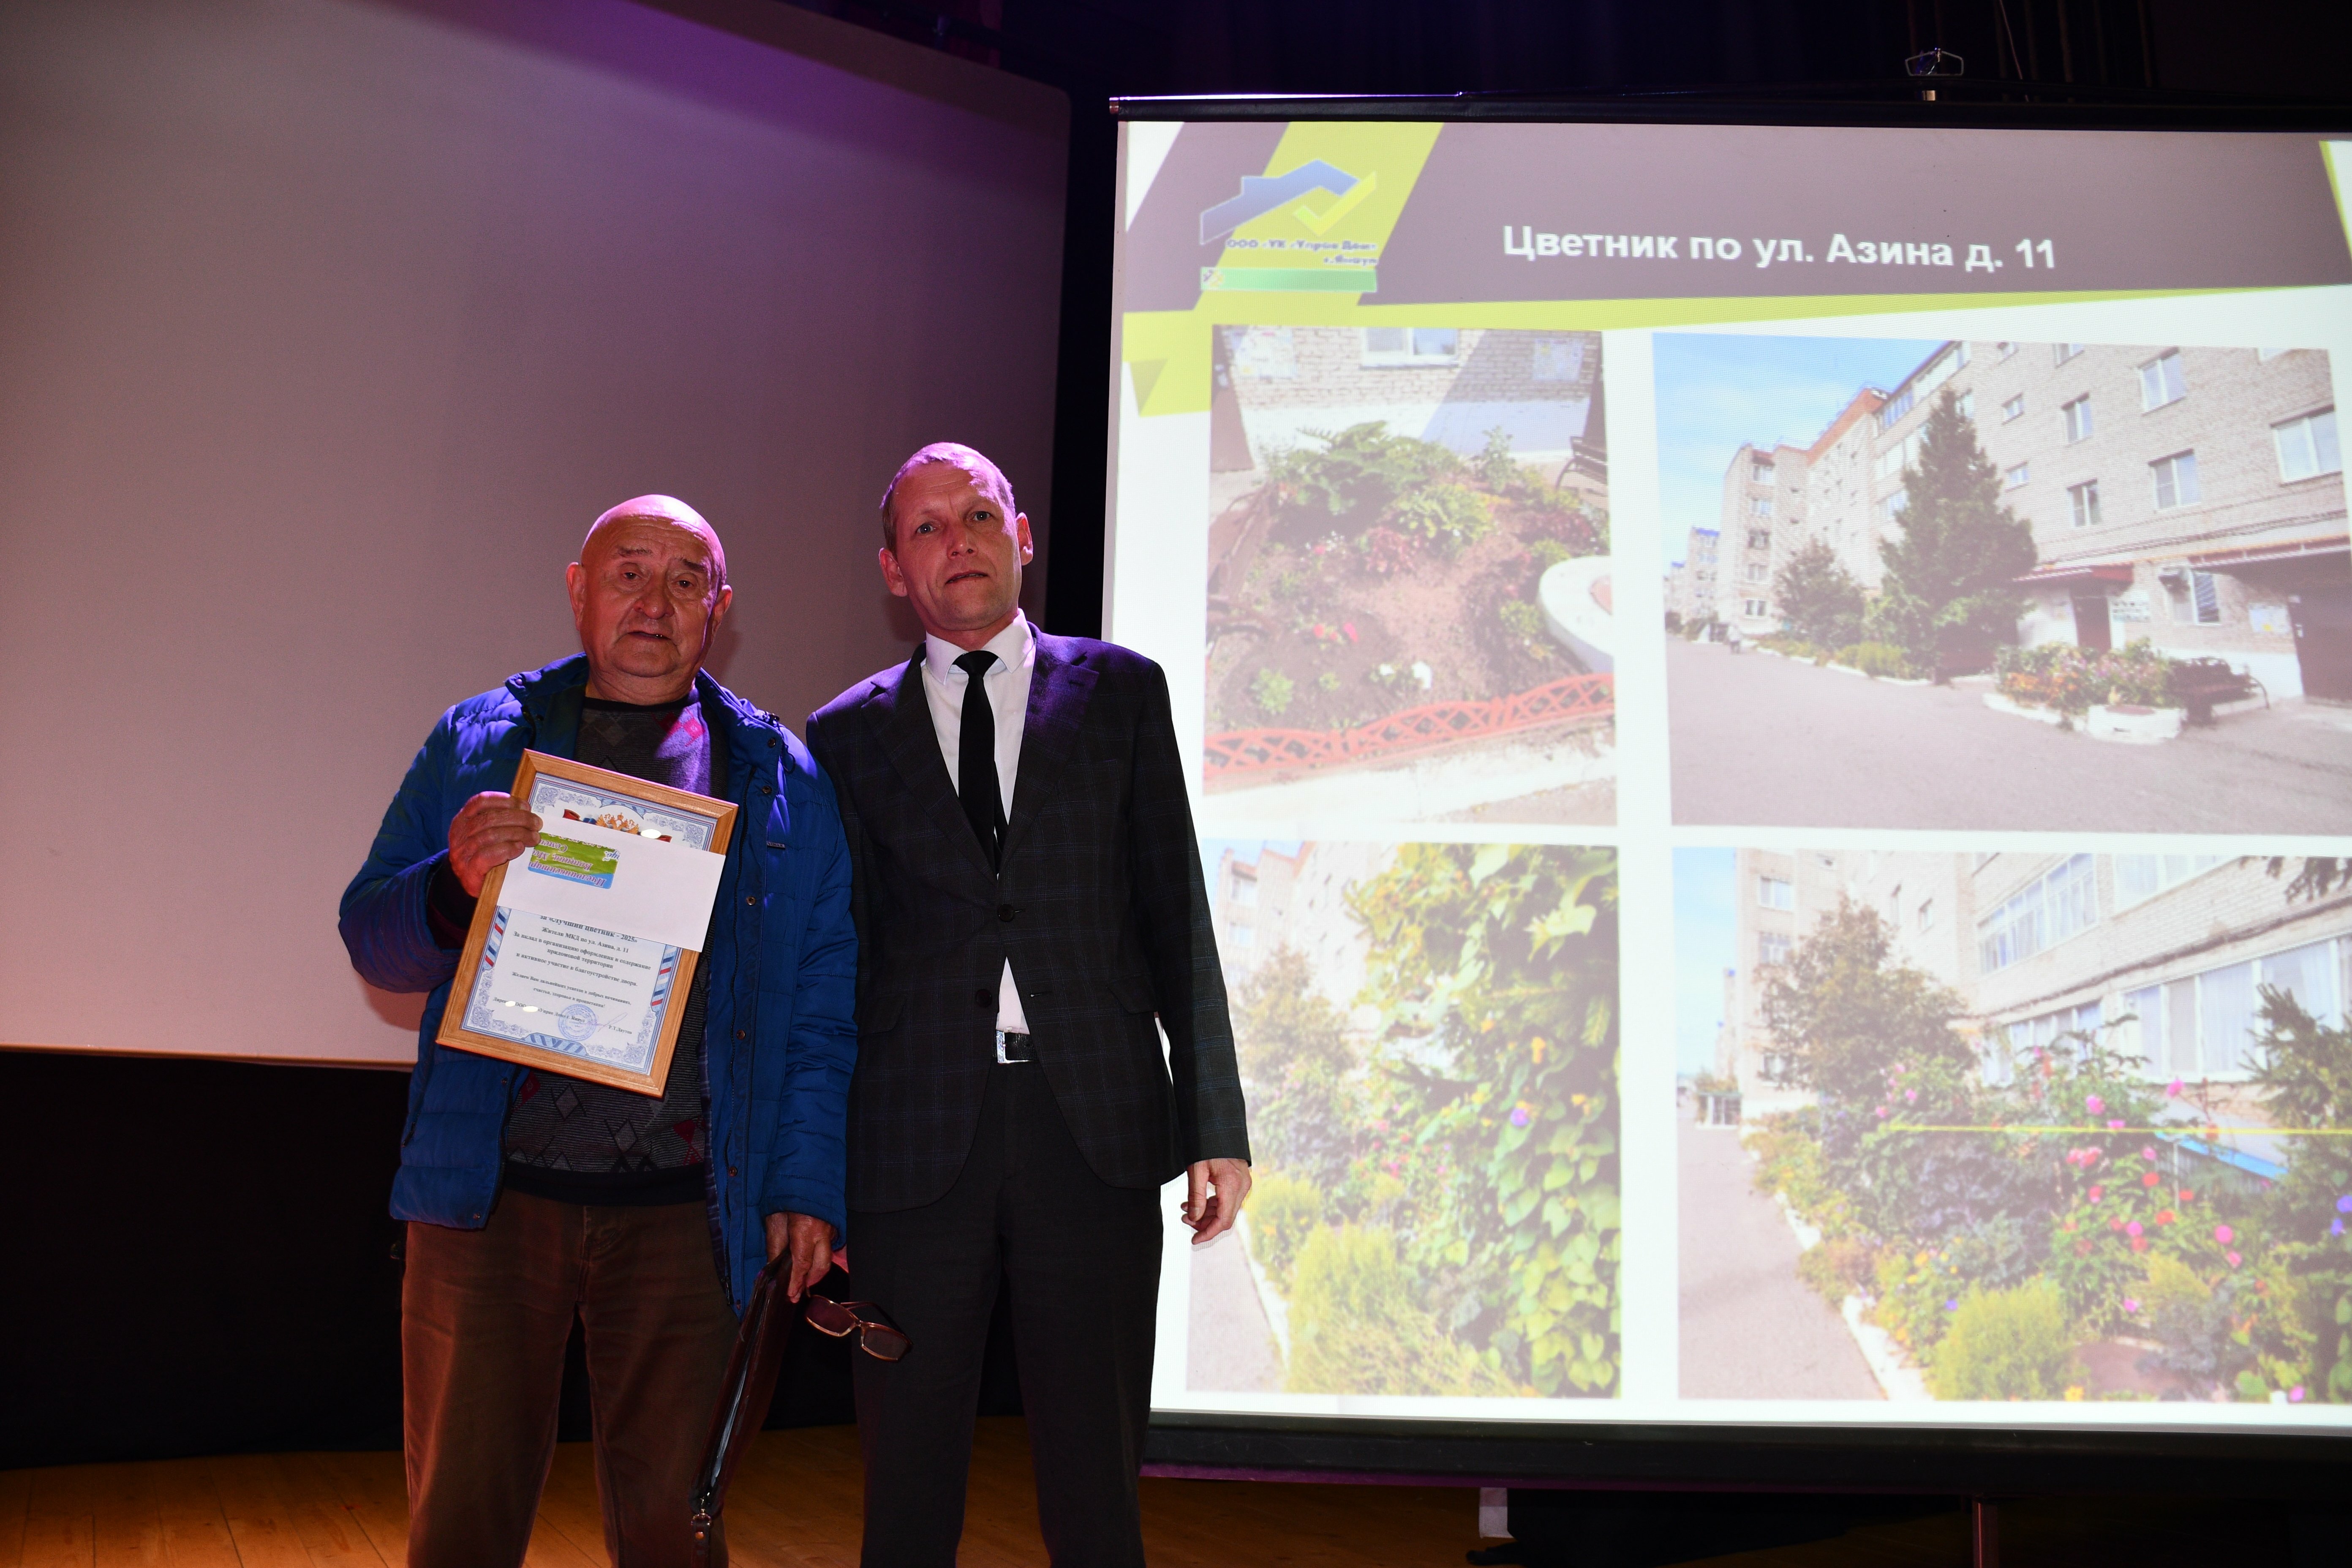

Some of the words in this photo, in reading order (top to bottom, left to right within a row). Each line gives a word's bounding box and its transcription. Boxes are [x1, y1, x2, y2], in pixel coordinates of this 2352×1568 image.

[1503, 224, 1679, 262] Цветник
[1689, 236, 1742, 261] по
[1752, 238, 1815, 269] ул.
[1826, 232, 1954, 267] Азина
[1964, 243, 2004, 273] д.
[2016, 238, 2055, 269] 11
[552, 854, 593, 871] Вощина,
[541, 926, 564, 937] Жители
[565, 932, 580, 942] МКД
[597, 941, 616, 950] Азина,
[620, 934, 640, 943] 2025»
[520, 934, 538, 942] вклад
[543, 940, 580, 952] организацию
[580, 949, 614, 961] оформления
[619, 959, 651, 970] содержание
[547, 949, 581, 961] придомовой
[581, 957, 614, 969] территории
[521, 954, 547, 964] активное
[547, 961, 569, 969] участие
[574, 966, 620, 982] благоустройстве
[512, 971, 529, 980] Желаем
[539, 979, 566, 989] дальнейших
